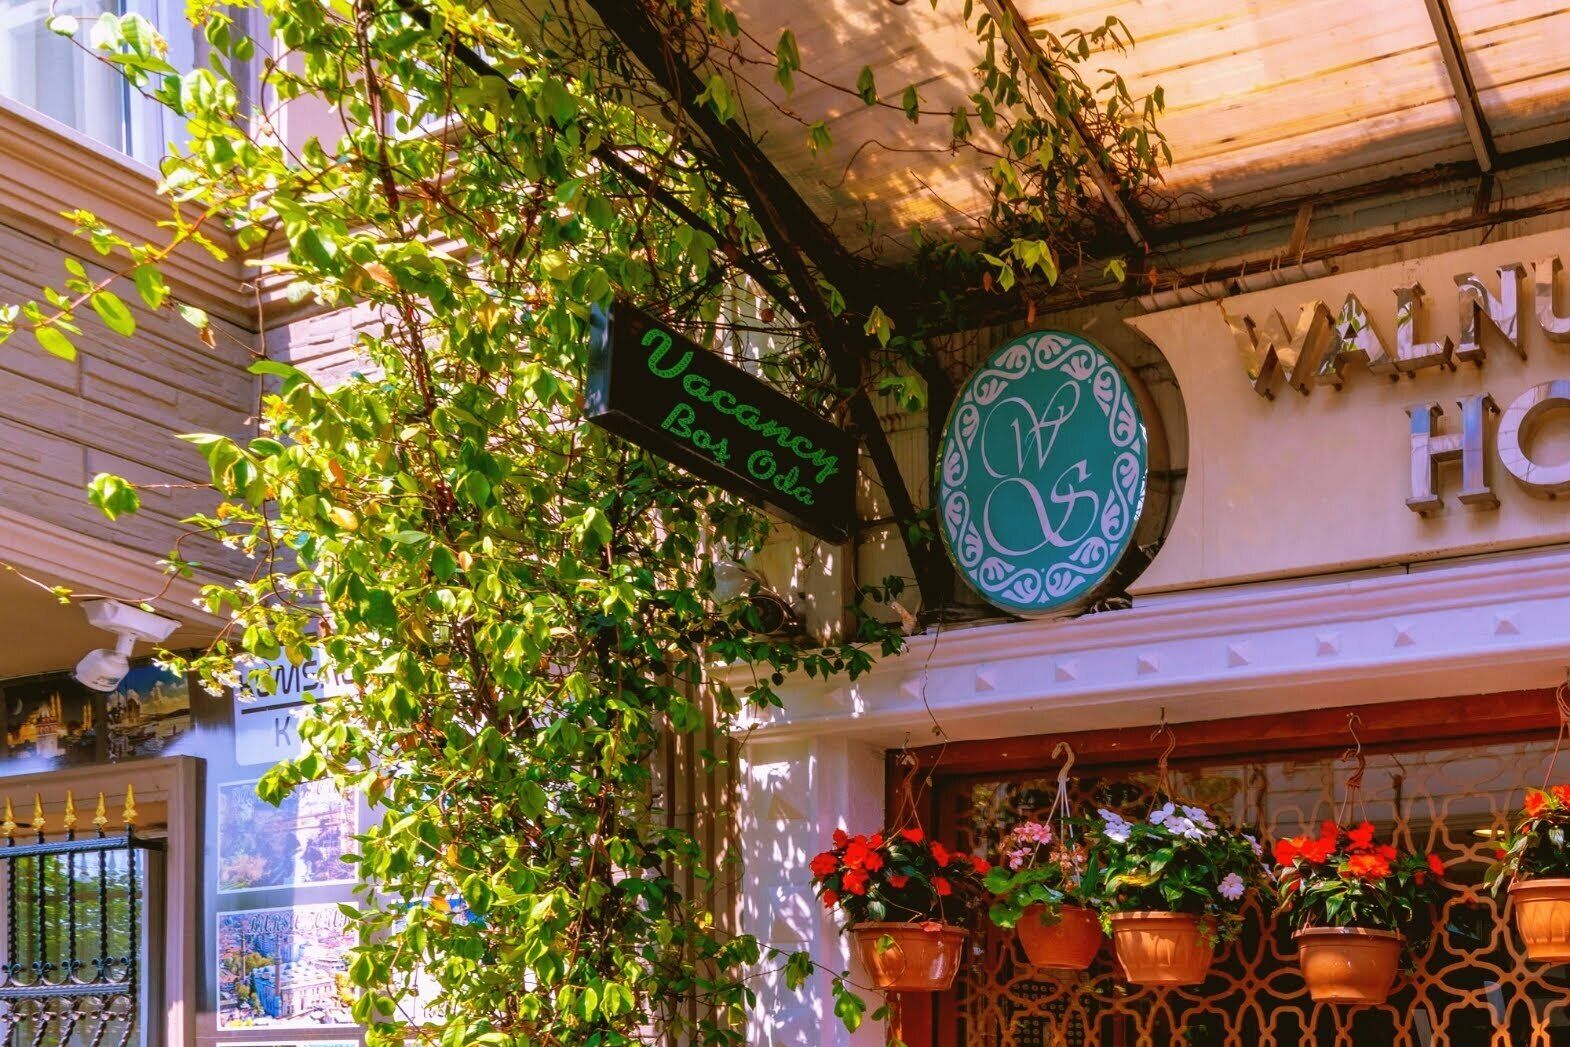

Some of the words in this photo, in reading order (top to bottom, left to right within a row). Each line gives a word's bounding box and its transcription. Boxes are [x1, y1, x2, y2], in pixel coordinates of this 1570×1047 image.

[641, 328, 839, 484] Vacancy
[661, 403, 731, 467] Boş
[747, 450, 815, 506] Oda
